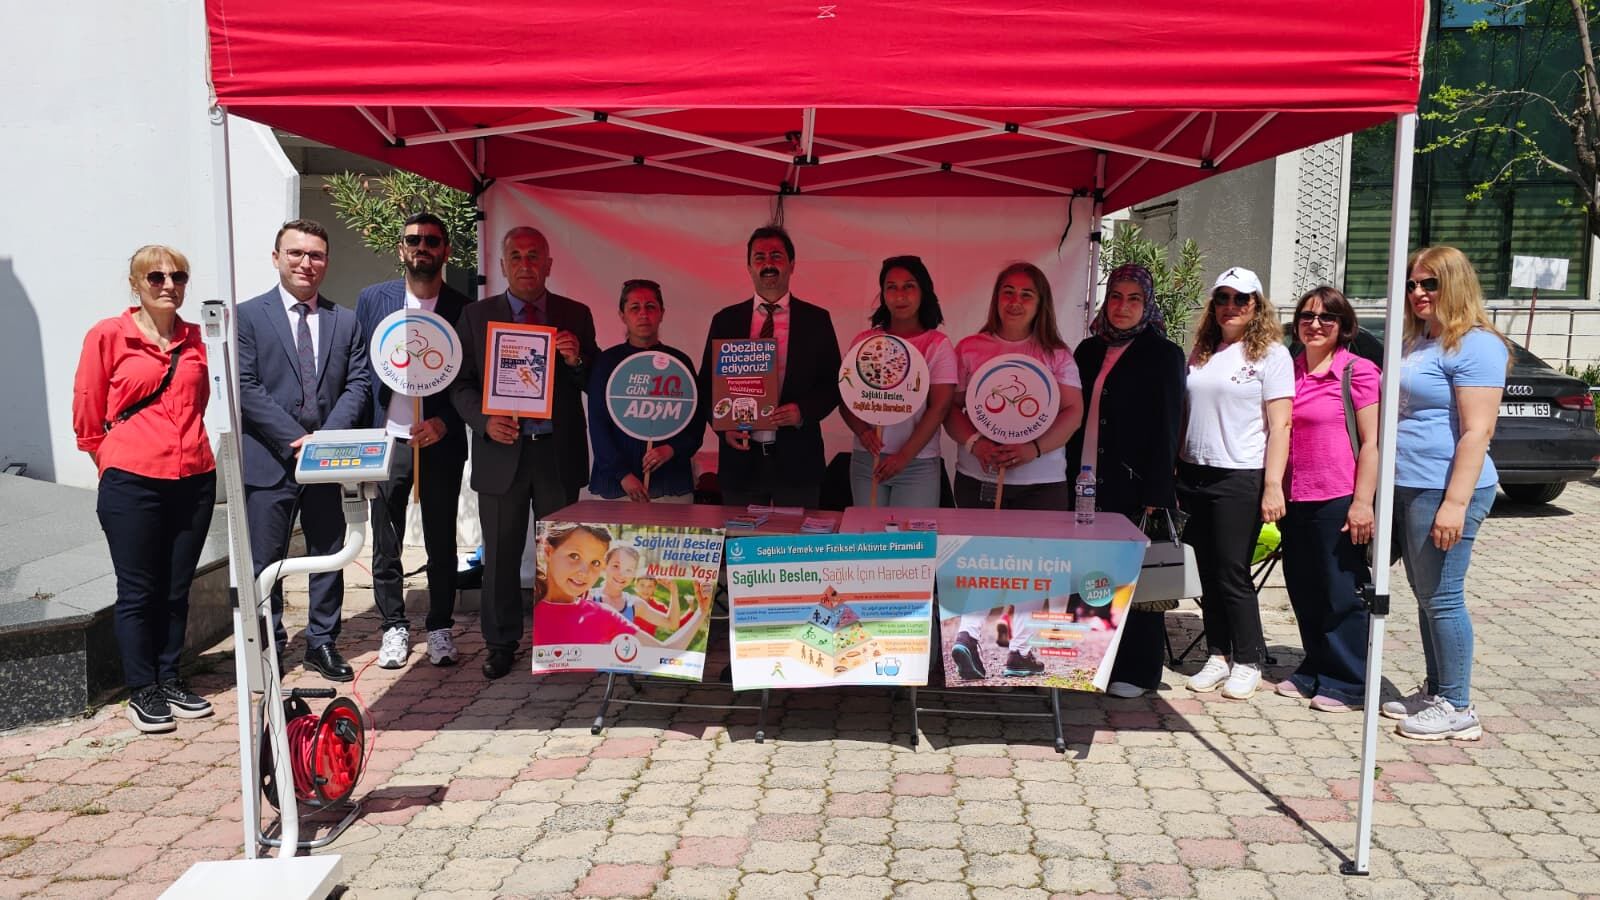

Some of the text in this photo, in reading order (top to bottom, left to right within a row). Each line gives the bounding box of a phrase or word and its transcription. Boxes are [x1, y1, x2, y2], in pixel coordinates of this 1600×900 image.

[721, 342, 776, 353] Obezite ile
[721, 352, 771, 363] mücadele
[381, 361, 401, 384] Sağlık
[417, 373, 449, 391] Hareket
[444, 363, 454, 373] Et
[721, 363, 768, 374] ediyoruz!
[628, 374, 650, 385] HER
[625, 383, 648, 395] GÜN
[861, 390, 905, 402] Sağlıklı Beslen,
[623, 400, 682, 421] ADIM
[1507, 404, 1549, 416] CTF 169
[975, 404, 1048, 438] Sağlık İçin Hareket Et
[634, 536, 722, 551] Sağlıklı Beslen
[757, 547, 787, 557] Sağlıklı
[788, 545, 814, 553] Yemek
[826, 544, 856, 553] Fiziksel
[857, 543, 888, 552] Aktivite
[889, 541, 924, 551] Piramidi
[663, 550, 710, 562] Hareket
[957, 554, 1072, 575] SAĞLIĞIN İÇİN
[647, 564, 718, 582] Mutlu Yaşa
[732, 564, 931, 588] Sağlıklı Beslen, Sağlık İçin Hareket Et
[956, 575, 1052, 592] HAREKET ET
